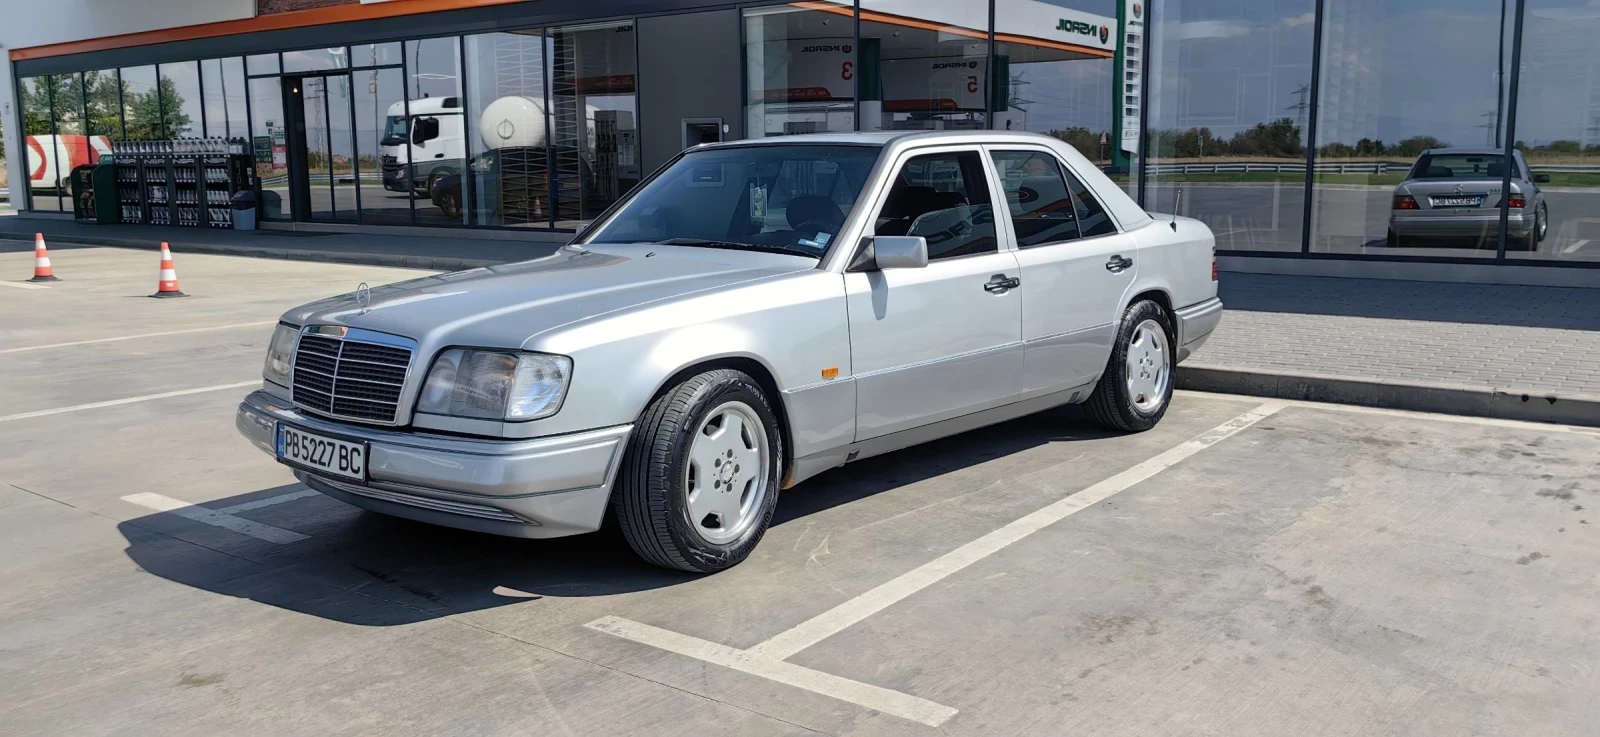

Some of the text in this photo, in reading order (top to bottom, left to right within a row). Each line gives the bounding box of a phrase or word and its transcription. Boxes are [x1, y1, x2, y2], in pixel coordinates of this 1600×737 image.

[285, 429, 361, 474] PB 5227 BC
